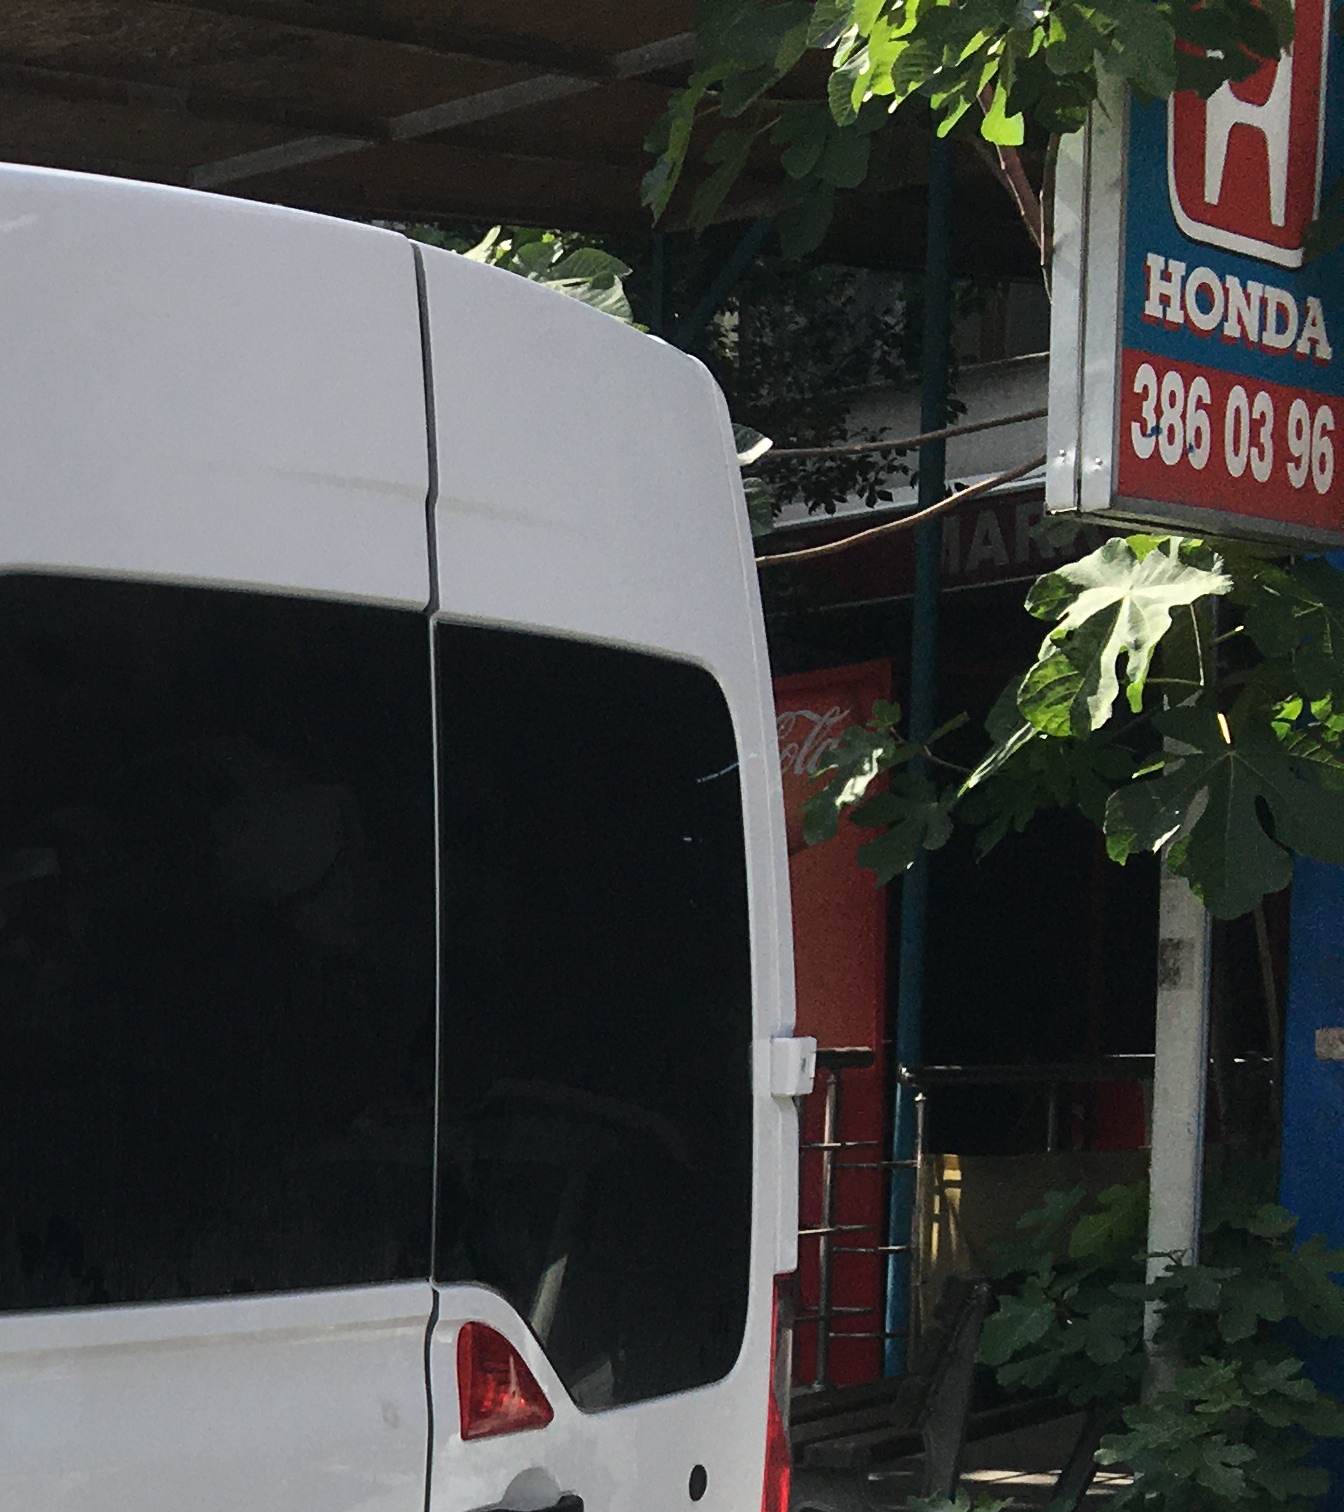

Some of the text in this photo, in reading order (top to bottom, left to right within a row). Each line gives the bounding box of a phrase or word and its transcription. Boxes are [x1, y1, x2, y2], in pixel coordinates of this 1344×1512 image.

[1144, 251, 1335, 366] HONDA
[1131, 362, 1336, 495] 386 03 96
